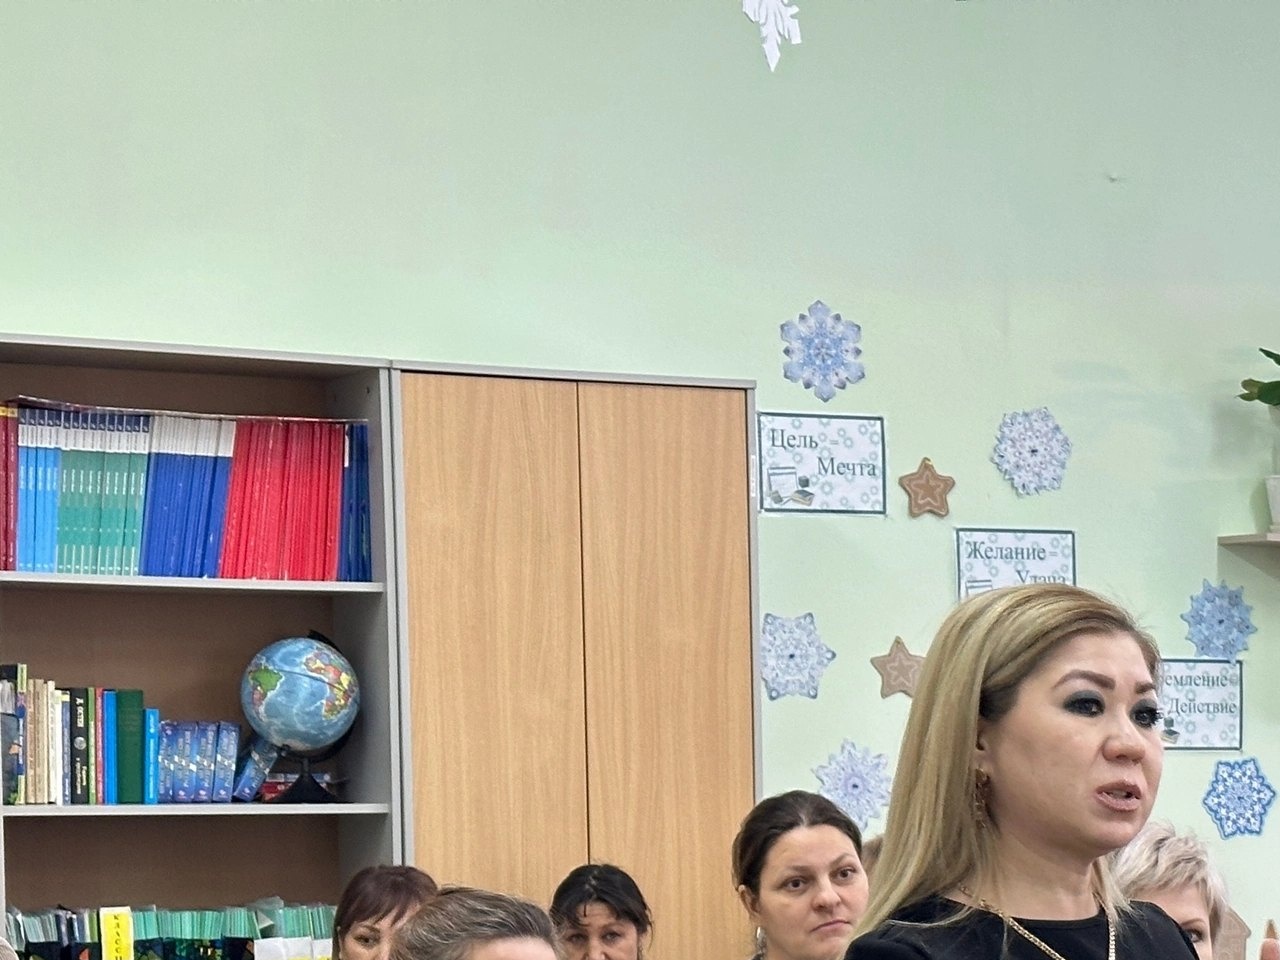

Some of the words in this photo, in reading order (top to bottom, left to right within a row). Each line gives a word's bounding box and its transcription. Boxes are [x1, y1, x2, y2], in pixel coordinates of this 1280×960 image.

[770, 428, 819, 450] Цель
[817, 456, 876, 477] Мечта
[965, 541, 1046, 560] Желание
[1164, 674, 1228, 688] емление
[1167, 698, 1237, 717] Действие
